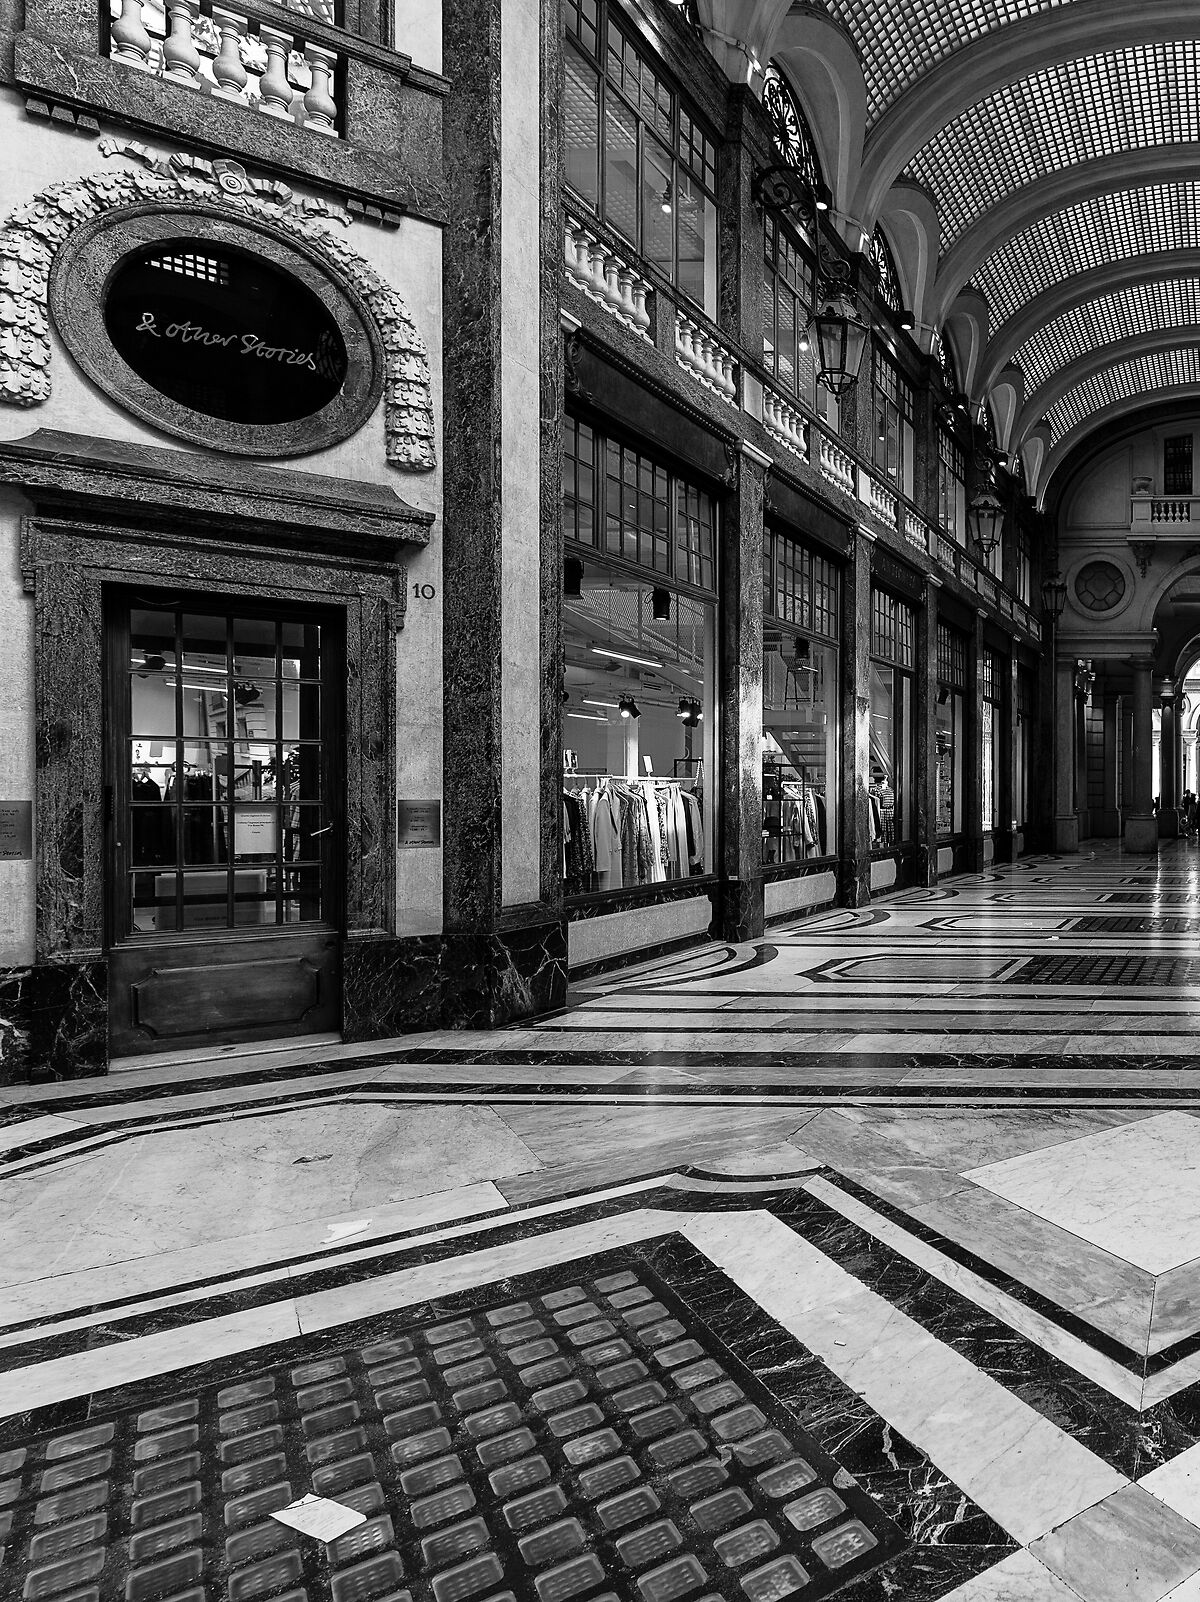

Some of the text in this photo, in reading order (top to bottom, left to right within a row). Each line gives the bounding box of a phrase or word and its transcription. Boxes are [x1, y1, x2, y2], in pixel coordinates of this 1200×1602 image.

[135, 312, 317, 371] & other Stories
[412, 582, 436, 600] 10
